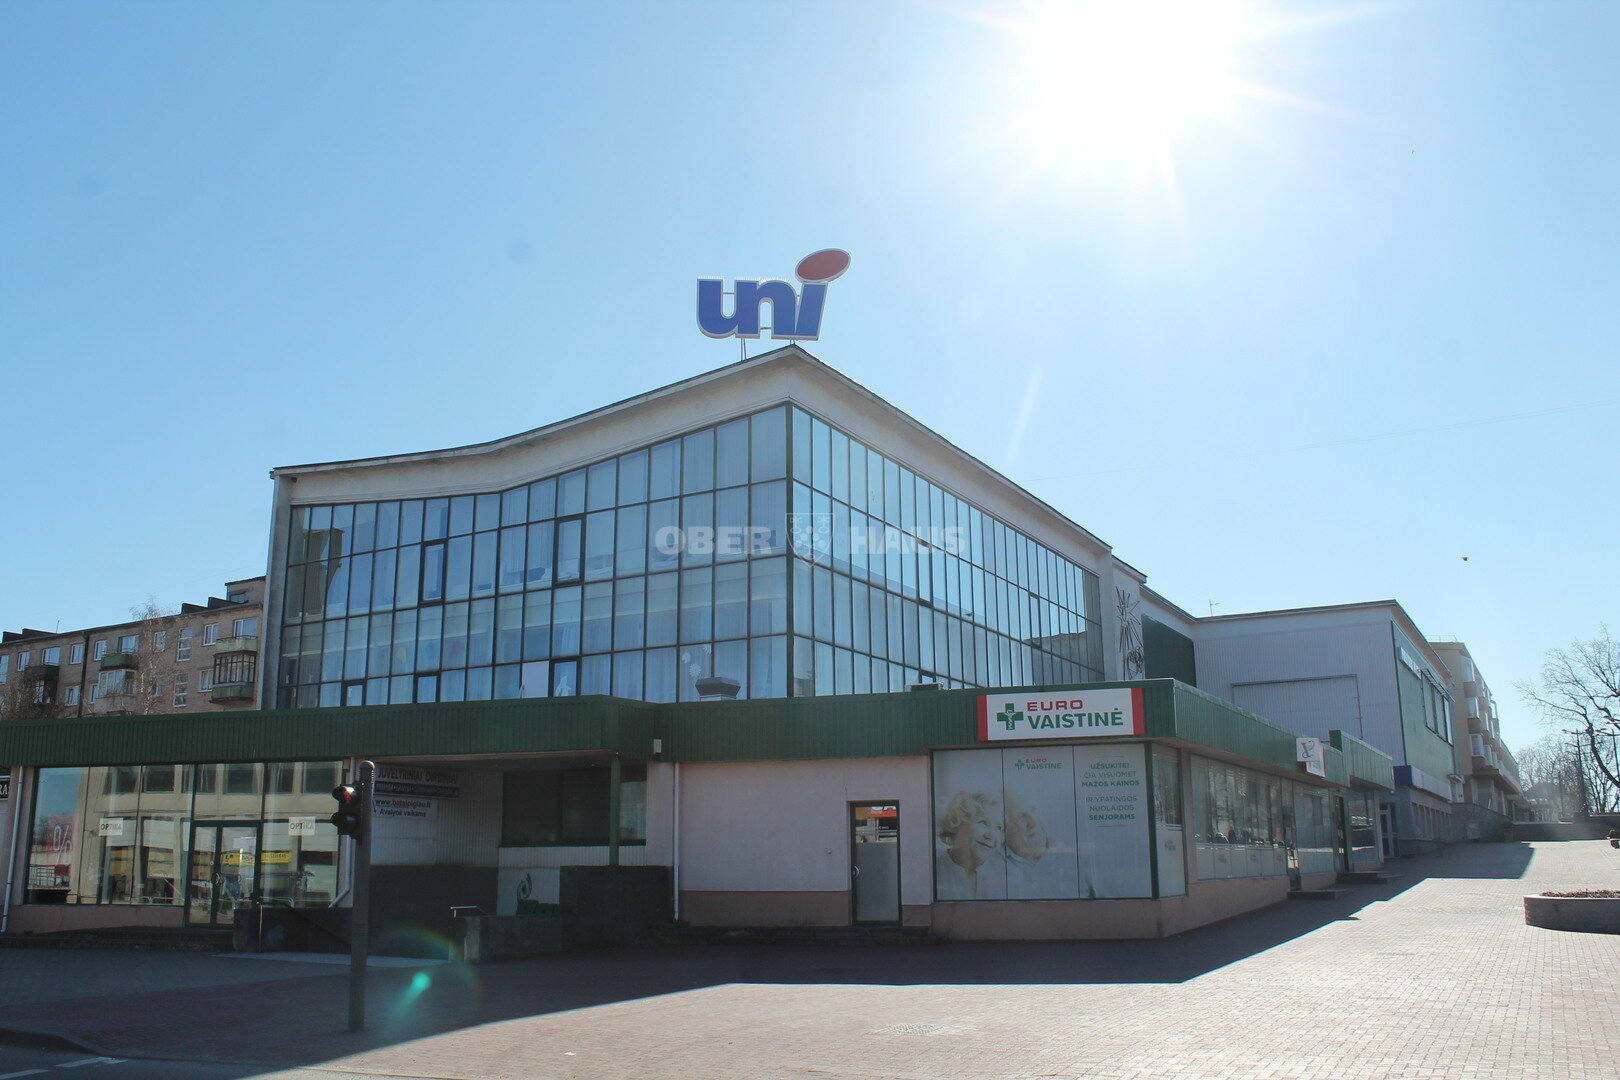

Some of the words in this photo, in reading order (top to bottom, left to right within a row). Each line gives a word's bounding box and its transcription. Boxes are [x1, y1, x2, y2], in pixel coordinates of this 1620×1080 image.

[697, 248, 851, 341] uni
[1027, 700, 1084, 712] EURO
[1027, 707, 1124, 730] VAISTINĖ
[1099, 771, 1137, 779] VISUOMET
[1110, 779, 1140, 787] KAINOS
[1095, 795, 1138, 803] YPATINGOS
[1089, 804, 1135, 812] NUOLAIDOS
[1088, 813, 1136, 821] SENJORAMS
[289, 821, 314, 830] OPTIKA
